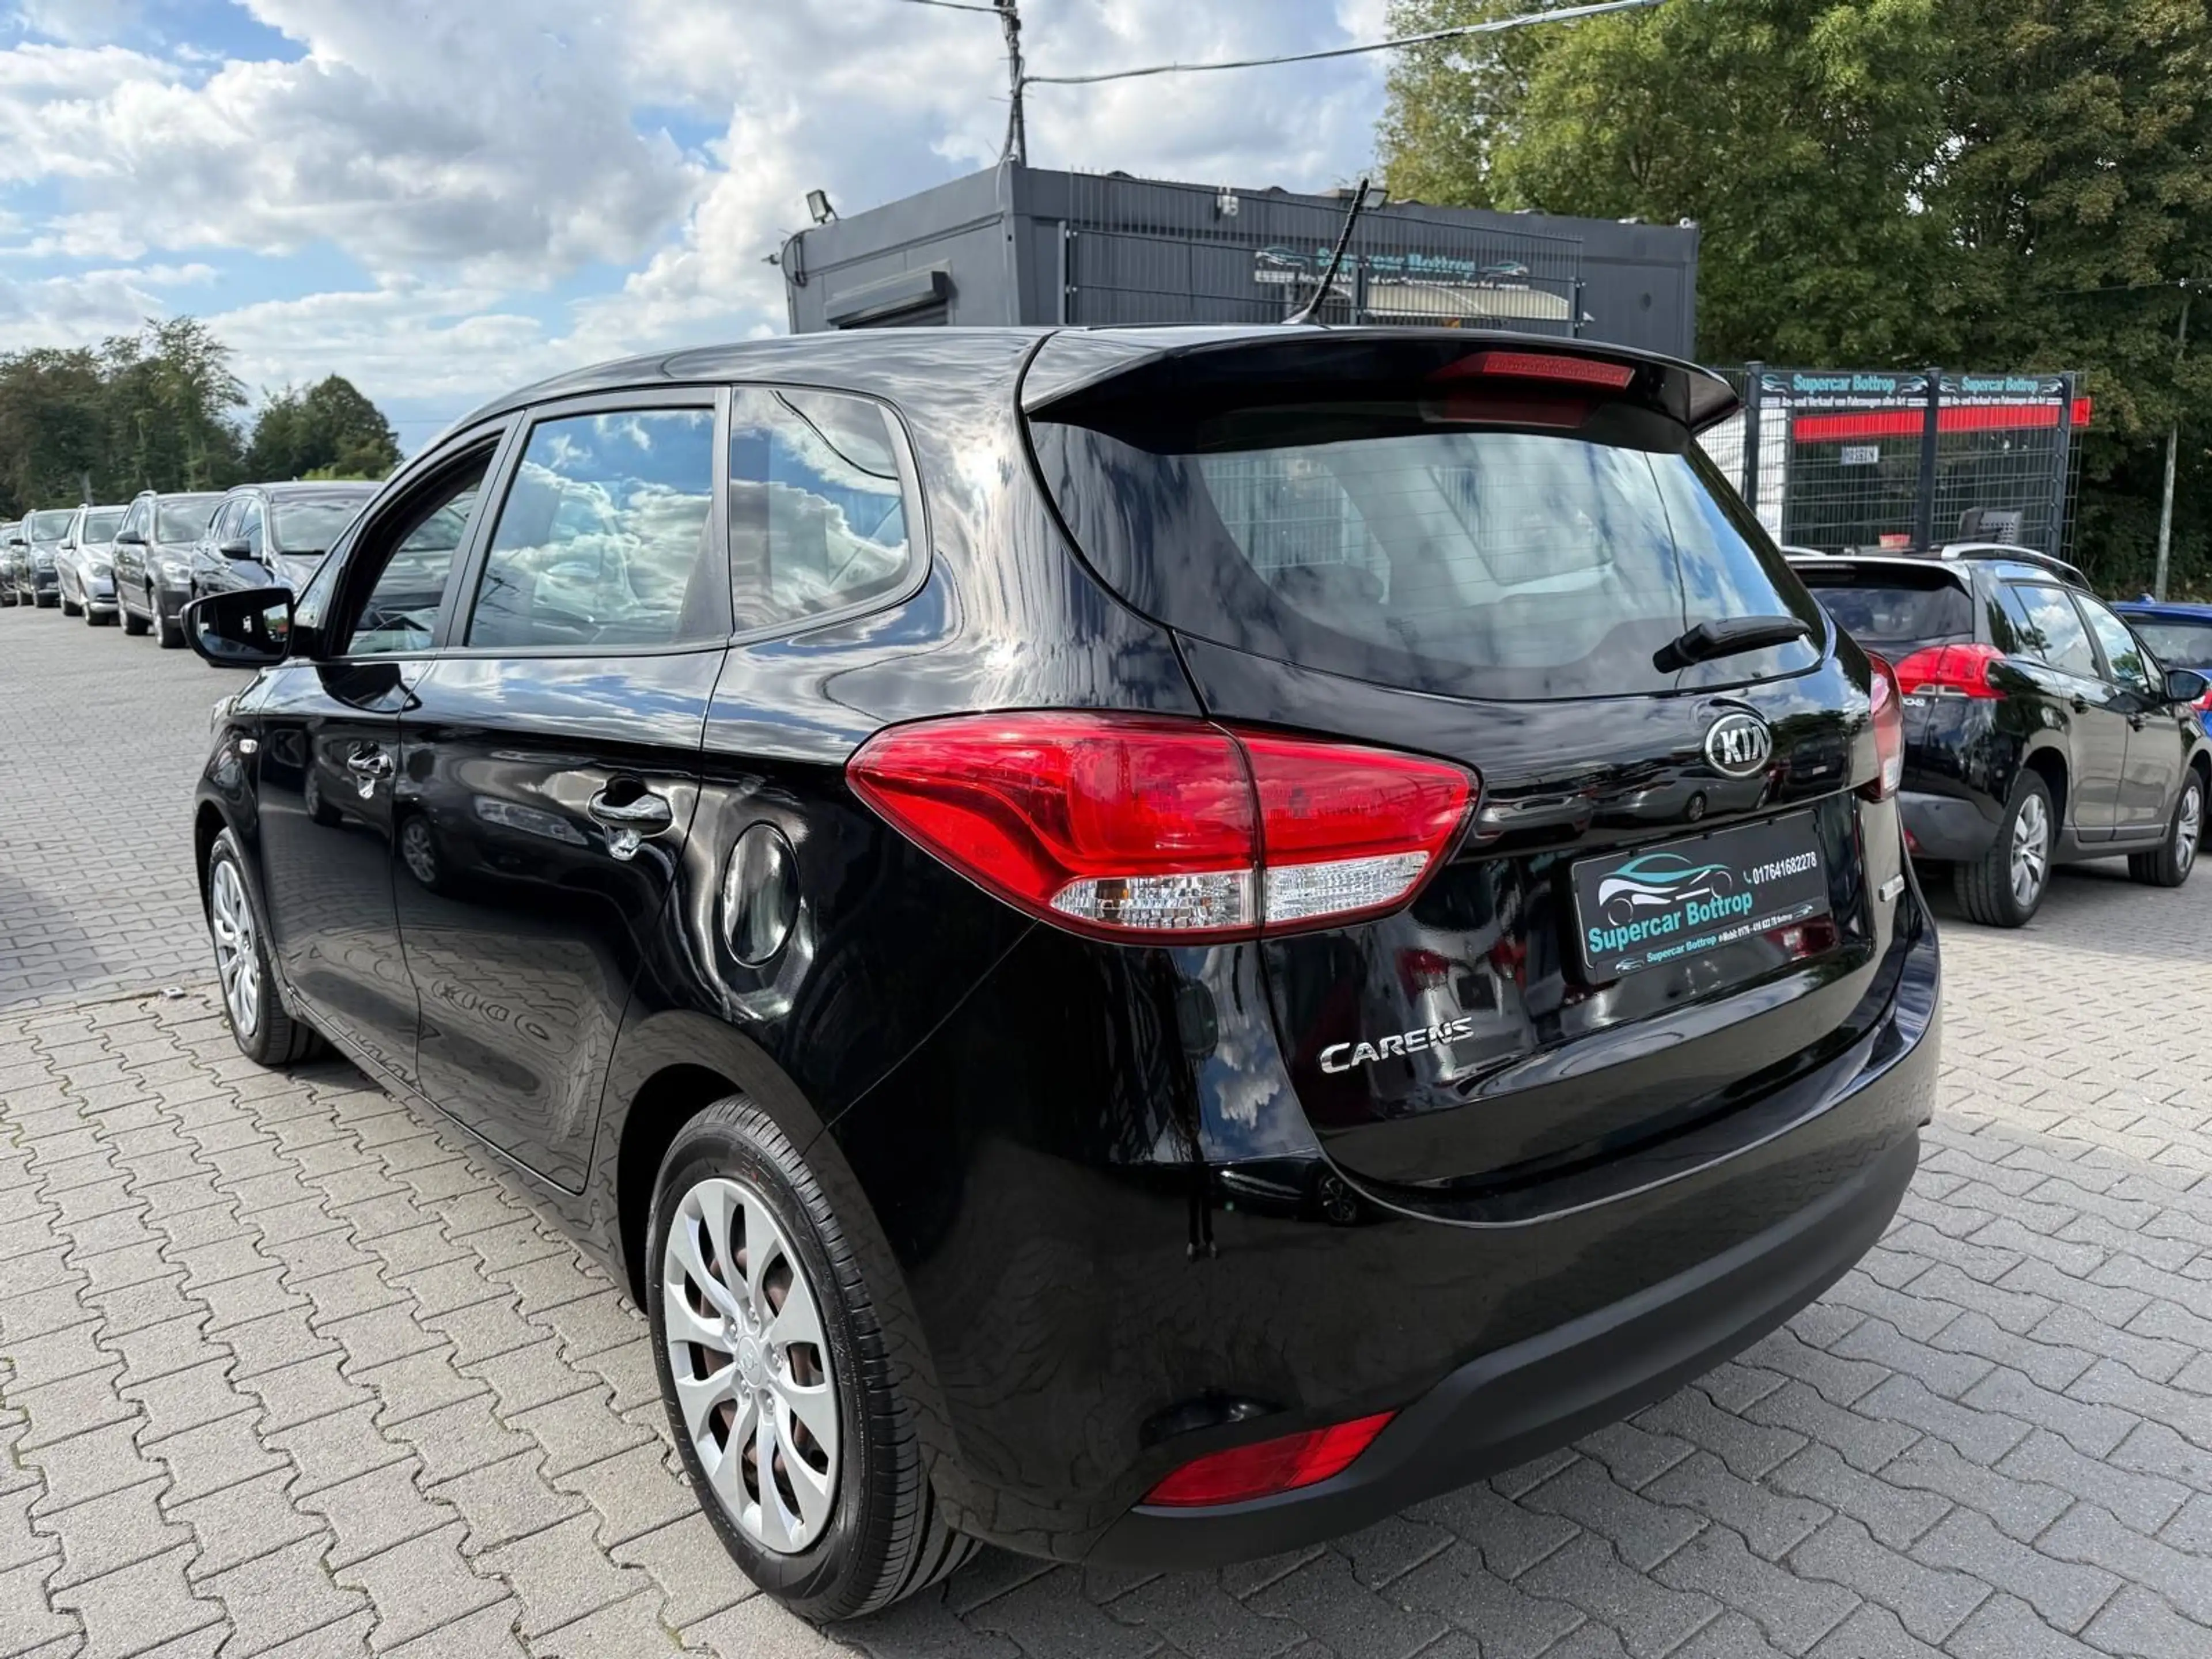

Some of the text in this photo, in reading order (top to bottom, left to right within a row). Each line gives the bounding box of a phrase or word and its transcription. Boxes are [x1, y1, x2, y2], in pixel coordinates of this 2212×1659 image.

[1793, 374, 1896, 395] Supercar Bottrop
[1961, 376, 2039, 395] Supercar Bottrop
[1753, 851, 1816, 885] 017641682278
[1588, 892, 1753, 953] Supercar Bottrop
[1647, 944, 1685, 963] Supercar
[1686, 935, 1717, 952] Bottrop
[1320, 1017, 1474, 1074] CARENS
